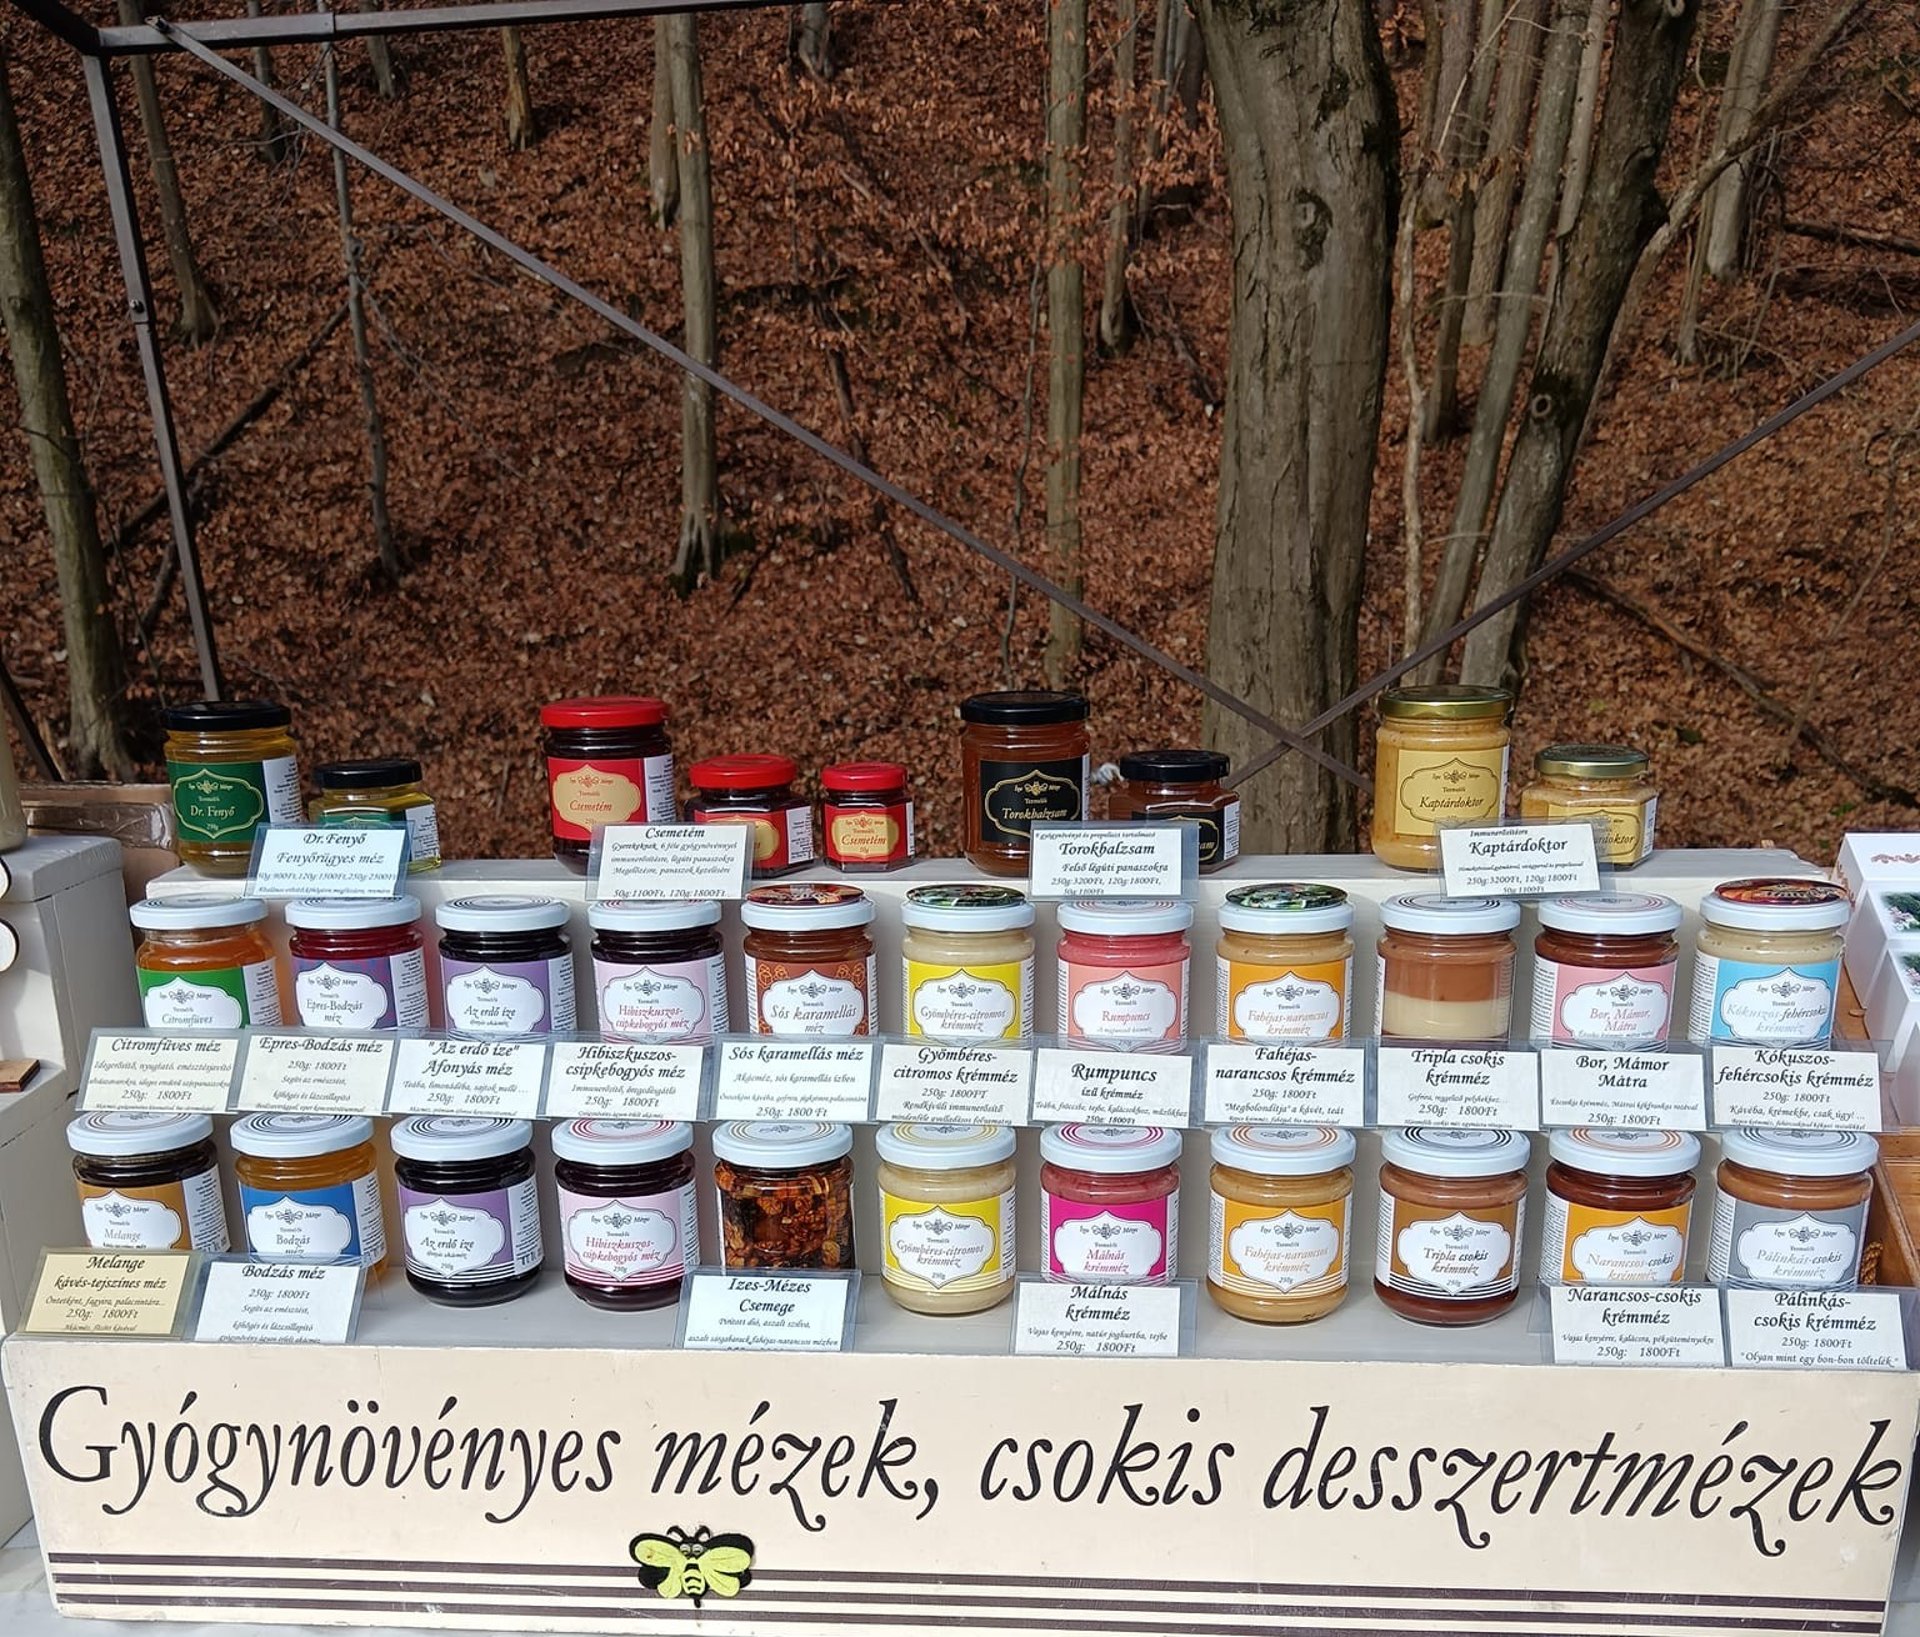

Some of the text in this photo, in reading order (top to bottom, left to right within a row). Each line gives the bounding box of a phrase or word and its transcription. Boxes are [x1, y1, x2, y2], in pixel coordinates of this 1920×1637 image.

[191, 805, 204, 816] Dr.
[1420, 796, 1484, 811] Kaptárdoktor
[1003, 808, 1067, 820] Torokbalzsam
[645, 828, 705, 839] Csemetém
[841, 835, 887, 846] Csemetém
[1060, 841, 1155, 858] Torokbalzsam
[1468, 837, 1568, 858] Kaptárdoktor
[277, 852, 384, 867] Fenyőrügyes méz
[1062, 862, 1087, 872] Felső
[1116, 862, 1168, 874] panaszokra
[306, 998, 364, 1013] Epres-Bodzás
[480, 1006, 499, 1017] erdő
[771, 1004, 858, 1021] Sós karamellás
[1102, 1009, 1152, 1025] Rumpuncs
[805, 1022, 826, 1034] méz
[112, 1037, 221, 1056] Citromfüves méz
[259, 1037, 384, 1053] Epres-Bodzás méz
[460, 1040, 490, 1056] erdő
[577, 1045, 677, 1064] Hibiszkuszos-
[728, 1045, 865, 1064] Sós karamellás méz
[917, 1046, 997, 1065] Gyömbéres-
[1254, 1046, 1317, 1066] Fahéjas-
[1410, 1050, 1505, 1068] Tripla csokis
[1754, 1049, 1836, 1067] Kókuszos-
[314, 1061, 346, 1071] 1800Ft
[486, 1062, 513, 1076] méz
[1575, 1055, 1670, 1072] Bor, Mámor
[566, 1062, 686, 1082] csipkebogyós méz
[893, 1065, 1019, 1085] citromos krémméz
[1071, 1062, 1158, 1085] Rumpuncs
[1215, 1066, 1356, 1085] narancsos krémméz
[1425, 1068, 1491, 1087] krémméz
[1714, 1066, 1875, 1089] fehércsokis krémméz
[1597, 1074, 1649, 1088] Mátra
[156, 1090, 192, 1101] 1800Ft
[464, 1093, 501, 1105] 1800Ft
[1099, 1086, 1144, 1101] krémméz
[1281, 1089, 1317, 1100] 1800Ft
[1794, 1092, 1831, 1104] 1800Ft
[622, 1096, 660, 1108] 1800Ft
[787, 1106, 813, 1117] 1800
[1457, 1105, 1498, 1117] 1800Ft
[1621, 1113, 1661, 1126] 1800Ft
[103, 1227, 142, 1243] Melange
[276, 1234, 311, 1249] Bodzás
[420, 1236, 475, 1252] Az erdő íze
[585, 1236, 656, 1253] Hibiszkuszos-
[640, 1249, 661, 1262] méz
[1085, 1248, 1126, 1261] Málnás
[1423, 1247, 1490, 1264] Tripla csokis
[86, 1254, 146, 1274] Melange
[242, 1262, 326, 1280] Bodzás méz
[1430, 1262, 1480, 1277] krémméz
[54, 1274, 168, 1293] kávés-tejszínes méz
[727, 1277, 812, 1294] Izes-Mézes
[276, 1289, 311, 1300] 1800Ft
[1069, 1285, 1128, 1300] Málnás
[1567, 1287, 1702, 1306] Narancsos-csokis
[1774, 1290, 1851, 1311] Pálinkás-
[102, 1308, 140, 1320] 1800Ft
[739, 1298, 796, 1316] Csemege
[1064, 1303, 1131, 1322] krémméz
[1602, 1308, 1671, 1327] krémméz
[1753, 1312, 1877, 1333] csokis krémméz
[1095, 1341, 1136, 1353] 1800Ft
[1781, 1336, 1853, 1350] 250g: 1800Ft
[1639, 1347, 1681, 1358] 1800Ft
[1776, 1353, 1797, 1363] mint
[1798, 1355, 1816, 1367] egy
[38, 1384, 1903, 1556] Gyógynövényes mézek, csokis desszertmézek
